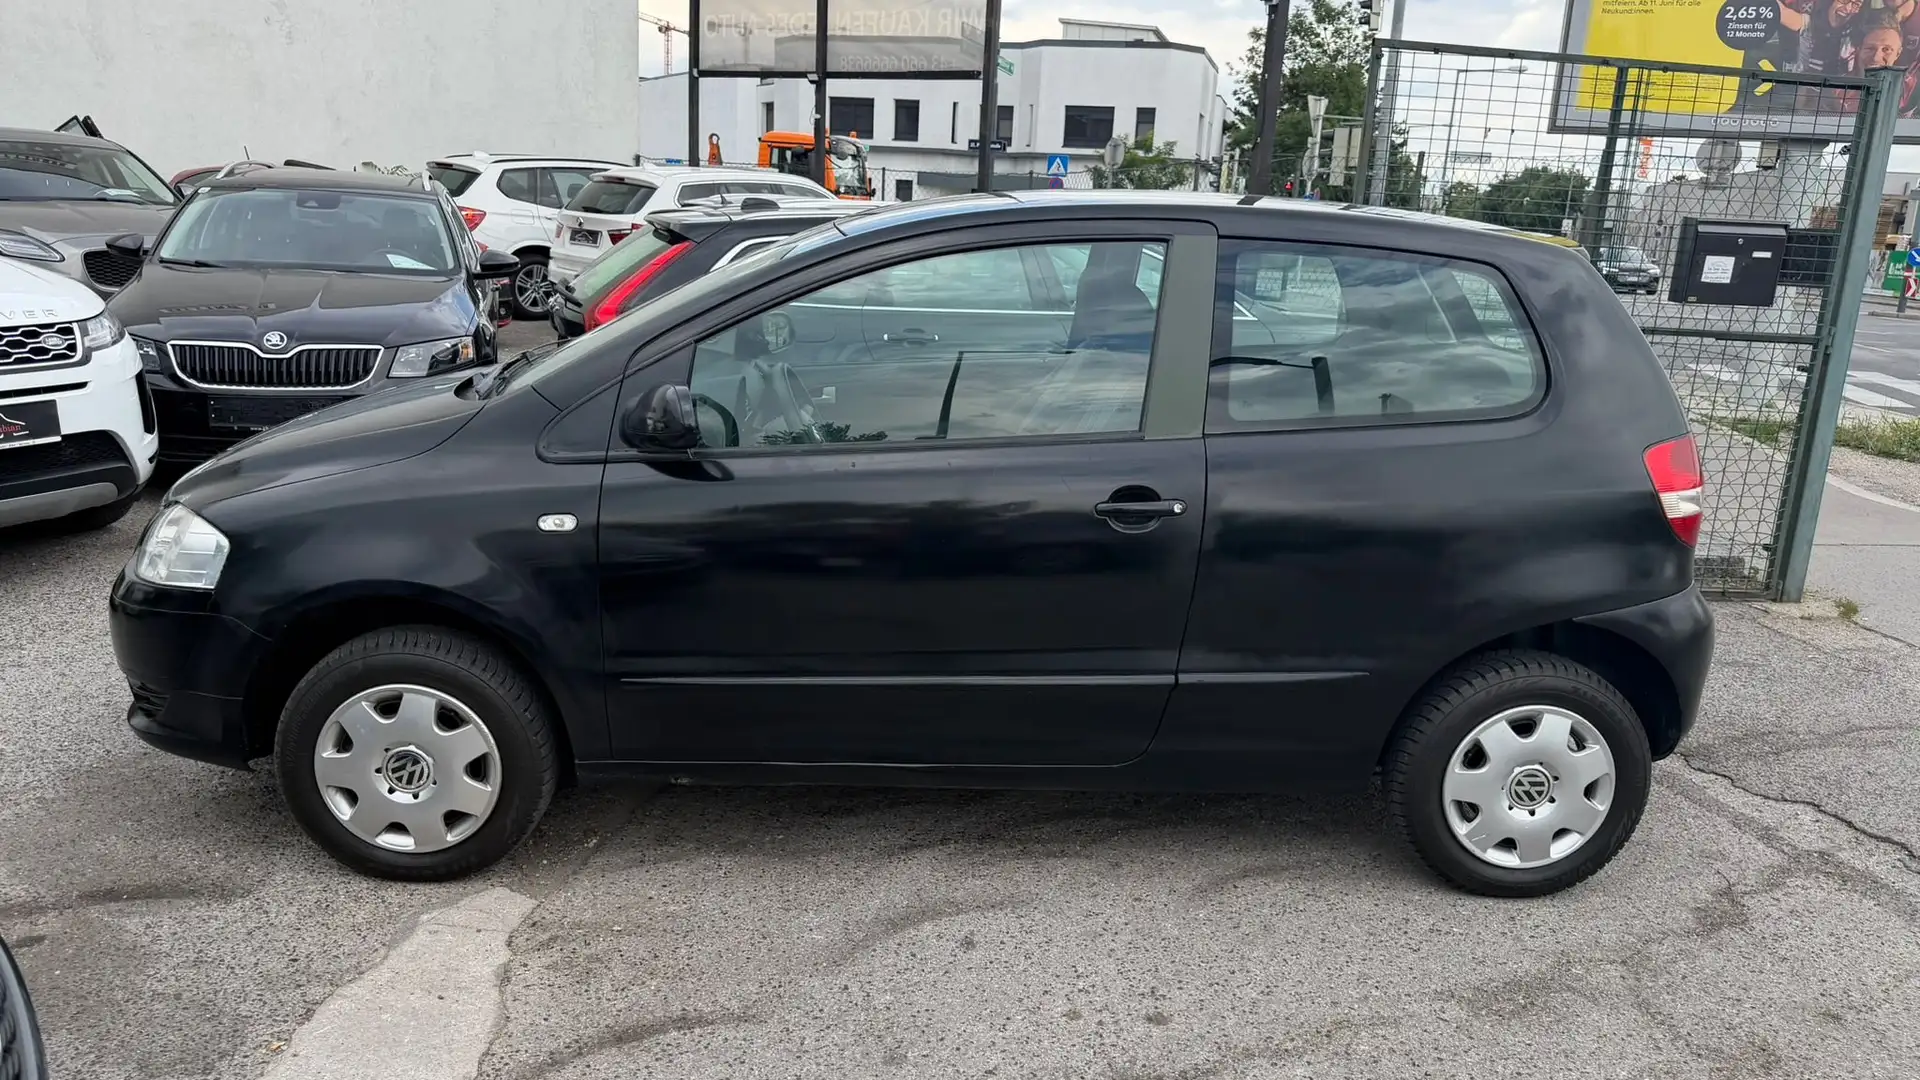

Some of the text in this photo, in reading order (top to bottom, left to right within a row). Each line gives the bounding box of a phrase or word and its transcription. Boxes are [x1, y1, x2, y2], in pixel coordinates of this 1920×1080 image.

[1724, 6, 1774, 20] 2,65 %
[1727, 22, 1767, 30] Zinsen für
